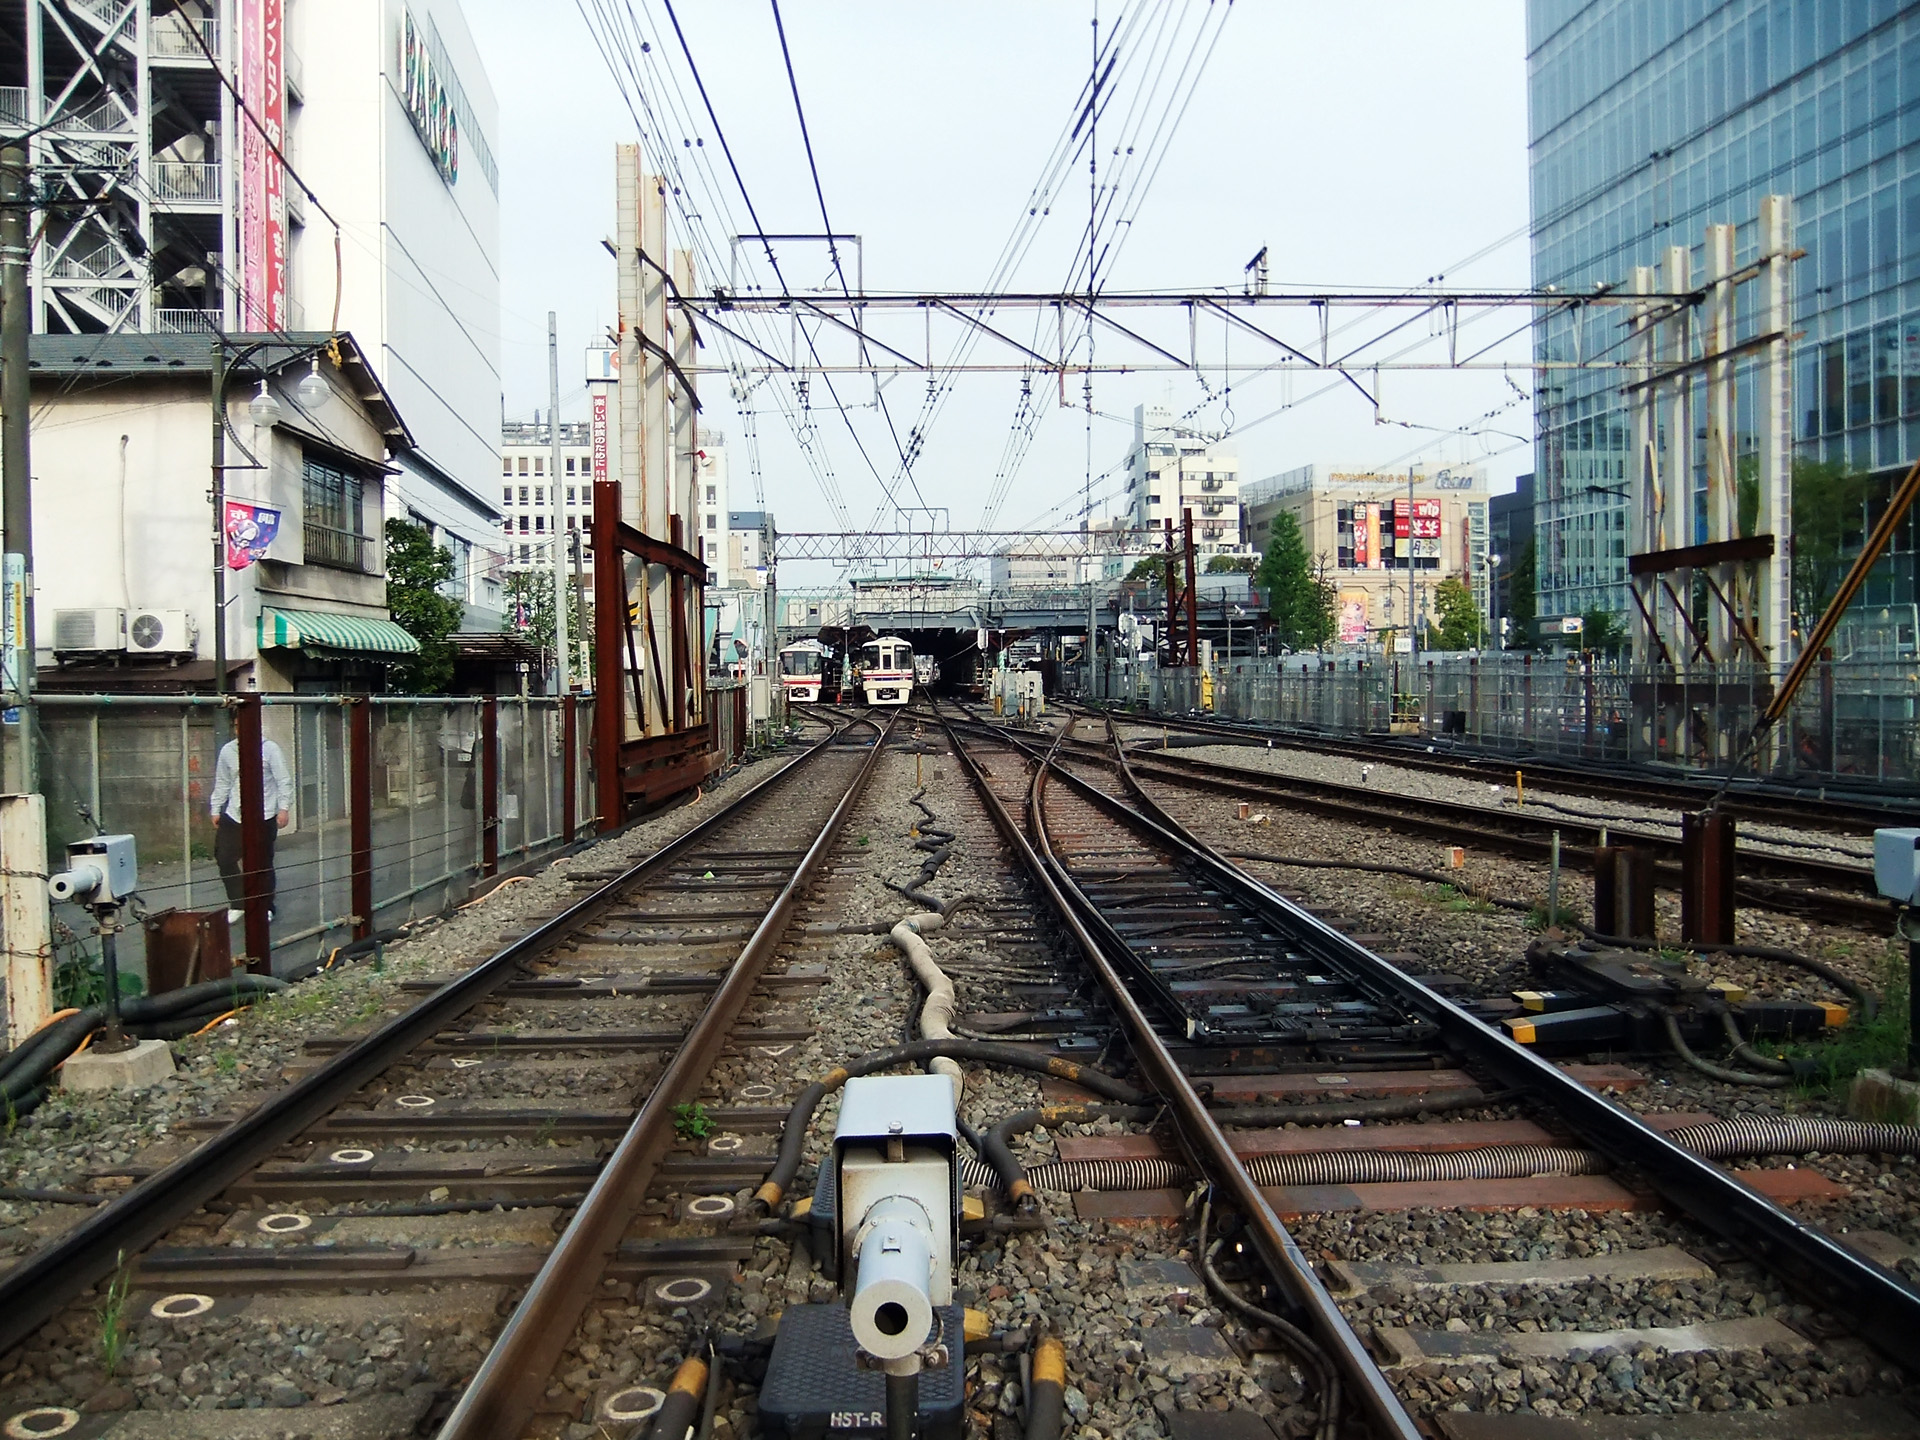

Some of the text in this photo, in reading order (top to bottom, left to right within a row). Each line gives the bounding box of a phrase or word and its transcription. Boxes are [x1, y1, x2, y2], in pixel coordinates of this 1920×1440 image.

[266, 0, 281, 107] ンフロア
[401, 5, 458, 187] PARCO
[594, 398, 606, 468] 楽しい家族のために
[830, 1411, 883, 1428] HST-R
